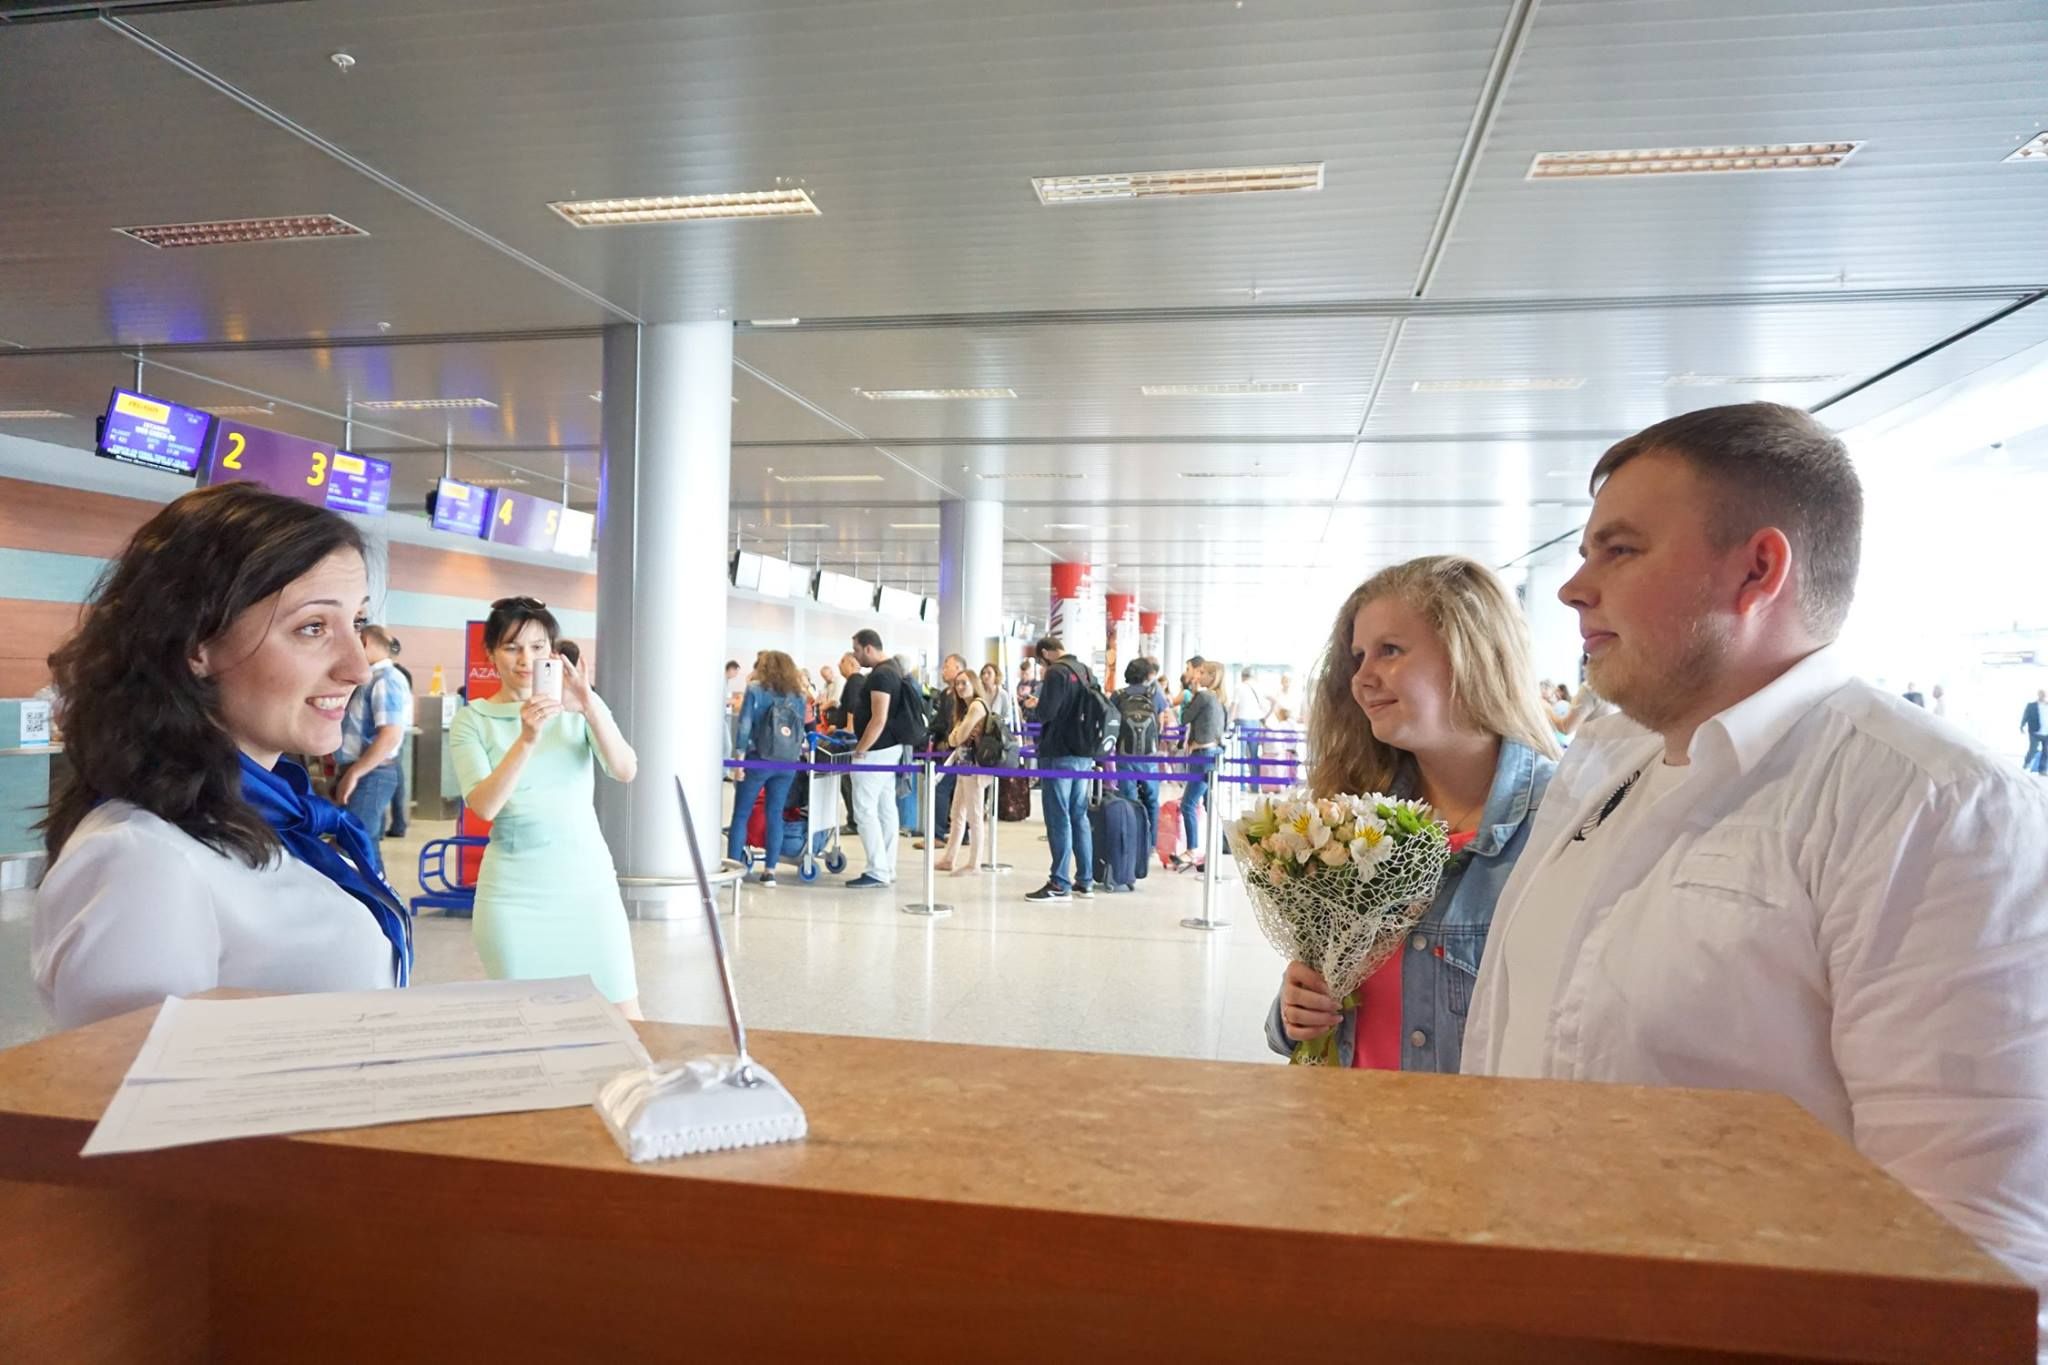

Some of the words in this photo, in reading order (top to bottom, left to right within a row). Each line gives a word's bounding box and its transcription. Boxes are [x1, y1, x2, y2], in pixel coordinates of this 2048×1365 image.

[223, 432, 246, 470] 2
[306, 451, 328, 487] 3
[499, 498, 513, 525] 4
[544, 509, 558, 535] 5
